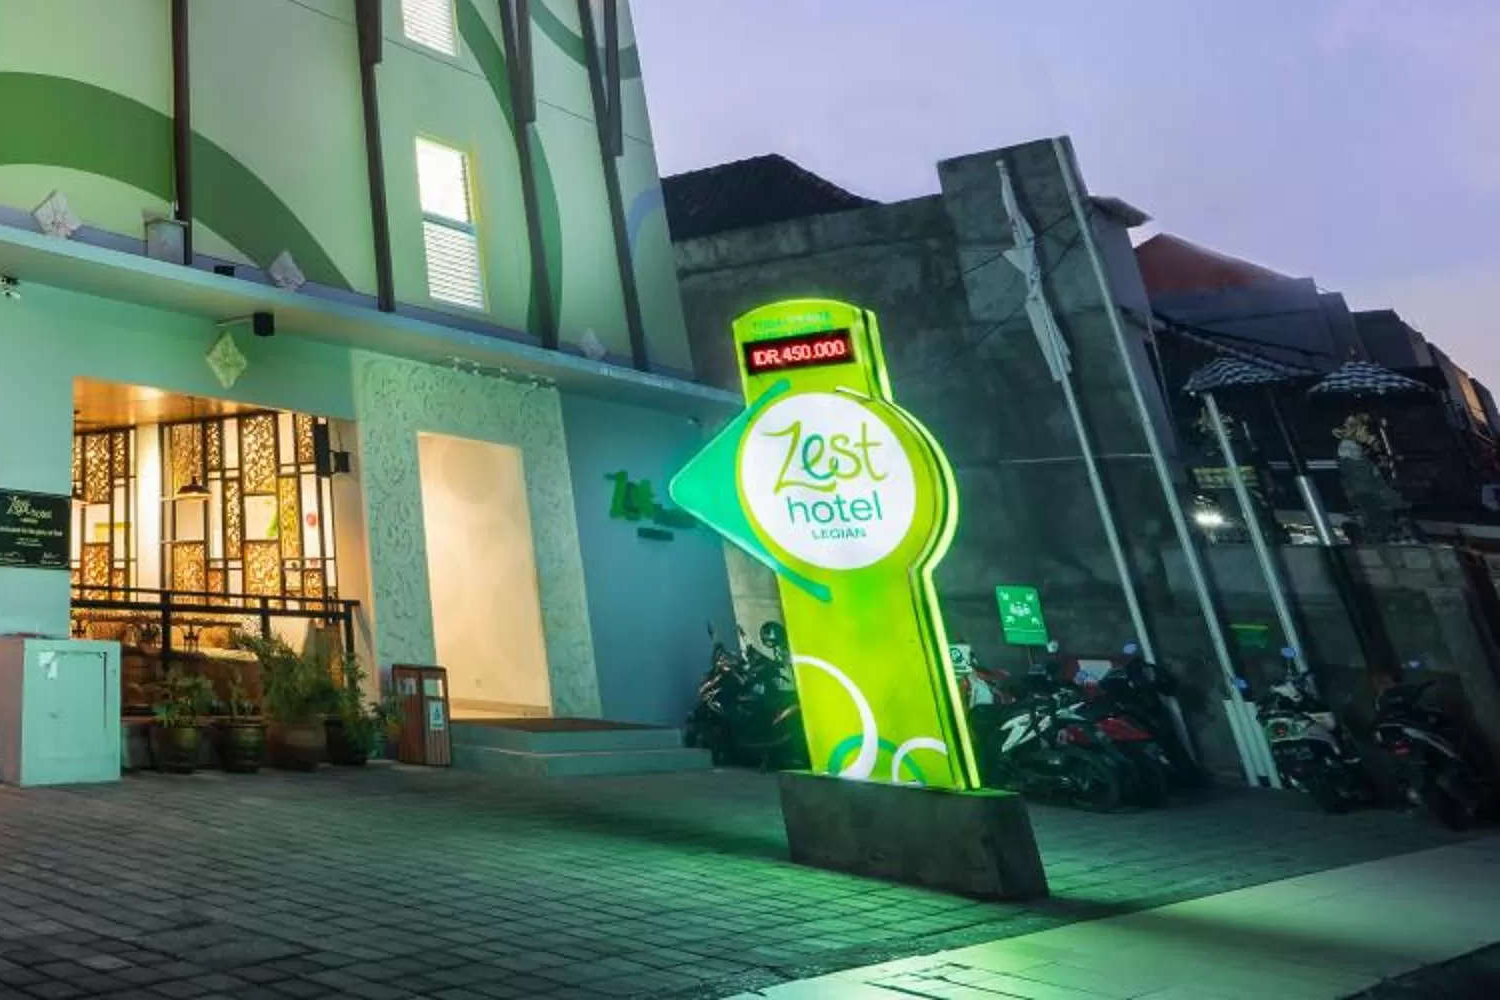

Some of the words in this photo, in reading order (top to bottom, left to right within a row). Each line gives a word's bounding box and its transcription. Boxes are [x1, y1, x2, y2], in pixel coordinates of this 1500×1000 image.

[761, 420, 888, 495] Zest
[786, 491, 884, 524] hotel
[811, 526, 867, 541] LEGIAN
